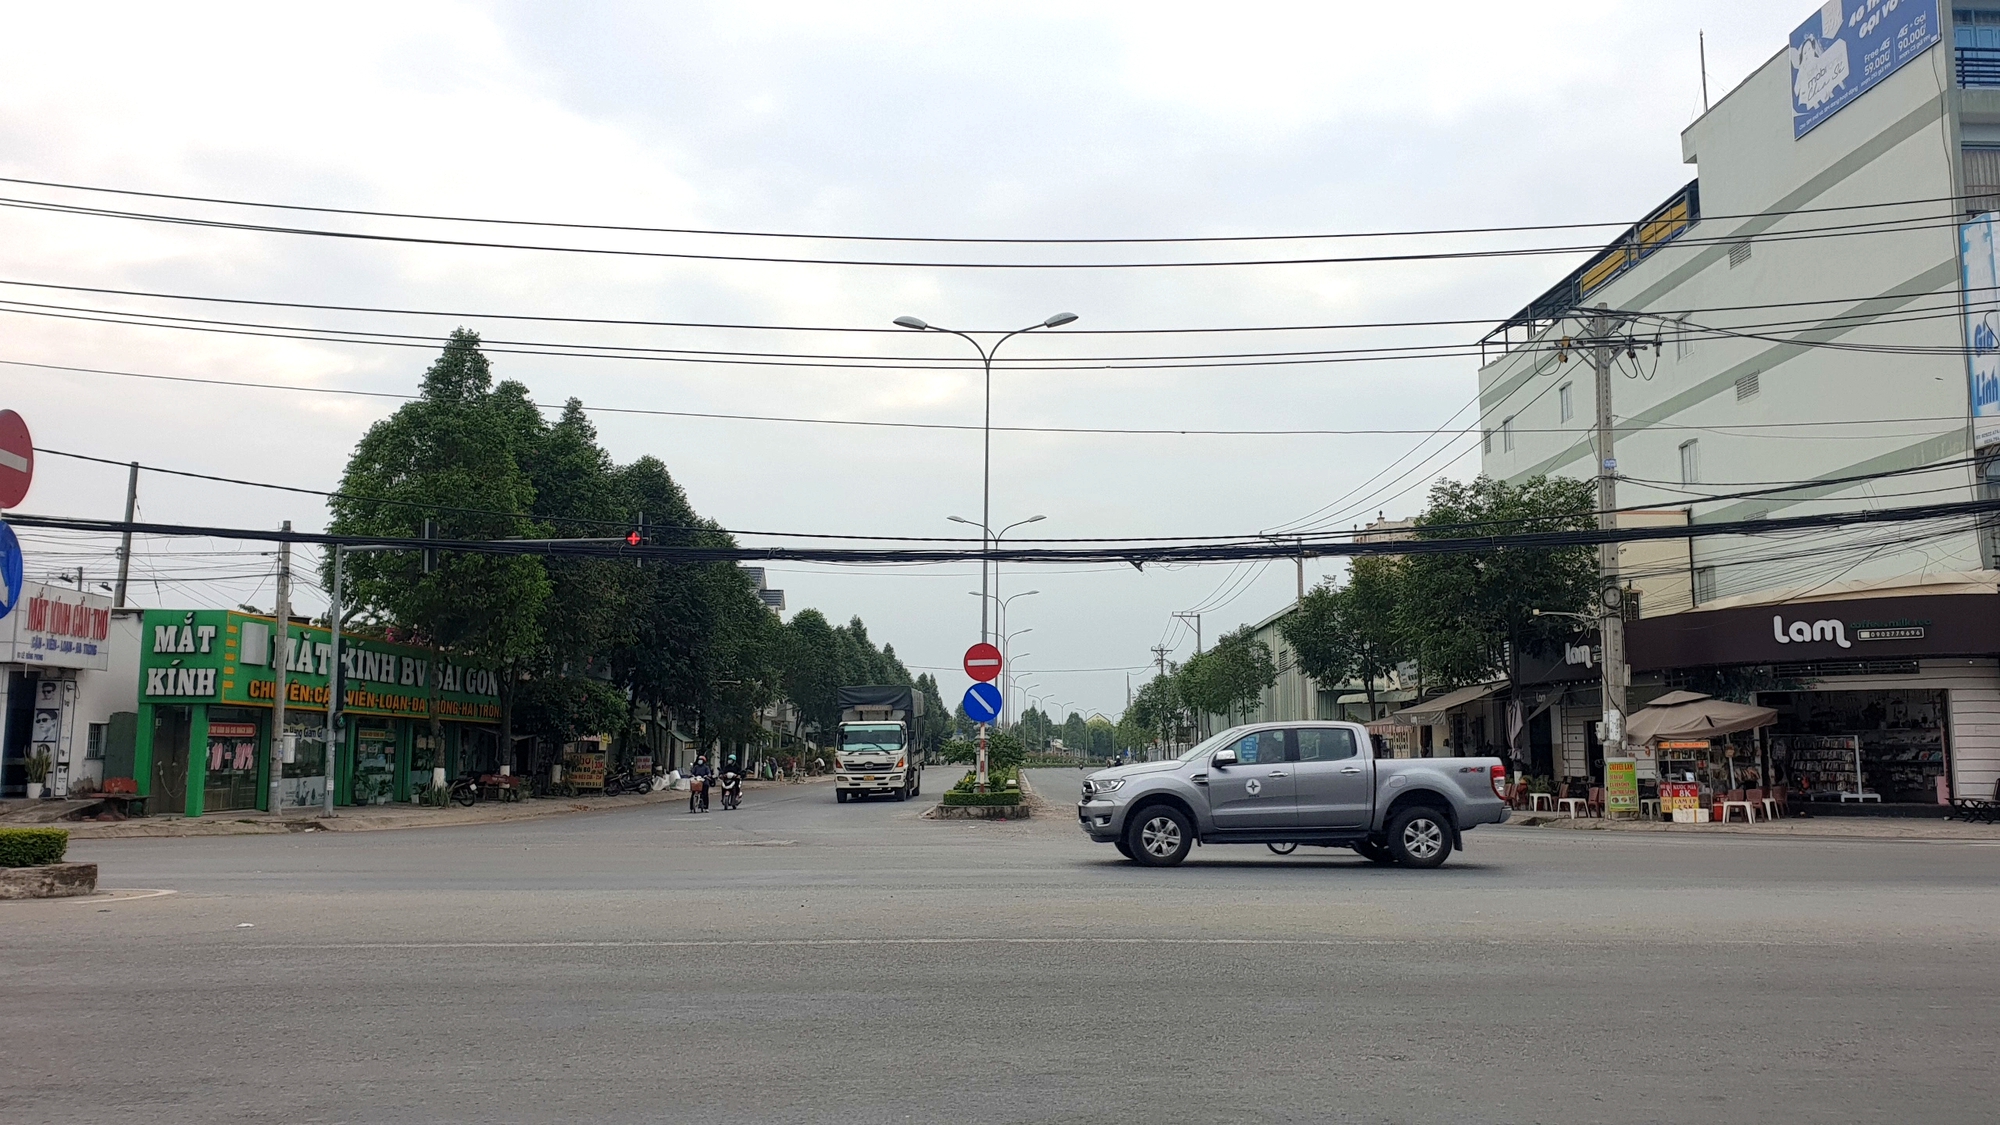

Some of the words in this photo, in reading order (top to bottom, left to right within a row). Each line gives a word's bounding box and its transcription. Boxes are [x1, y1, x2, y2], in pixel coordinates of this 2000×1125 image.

[1864, 48, 1879, 64] Free
[1976, 366, 1998, 406] Linh
[50, 596, 72, 636] KÍNH
[92, 606, 109, 641] THƠ
[153, 611, 215, 653] MẮT
[145, 660, 216, 696] KÍNH
[342, 641, 396, 684] KÍNH
[400, 656, 428, 687] BV
[1679, 789, 1691, 797] 8K
